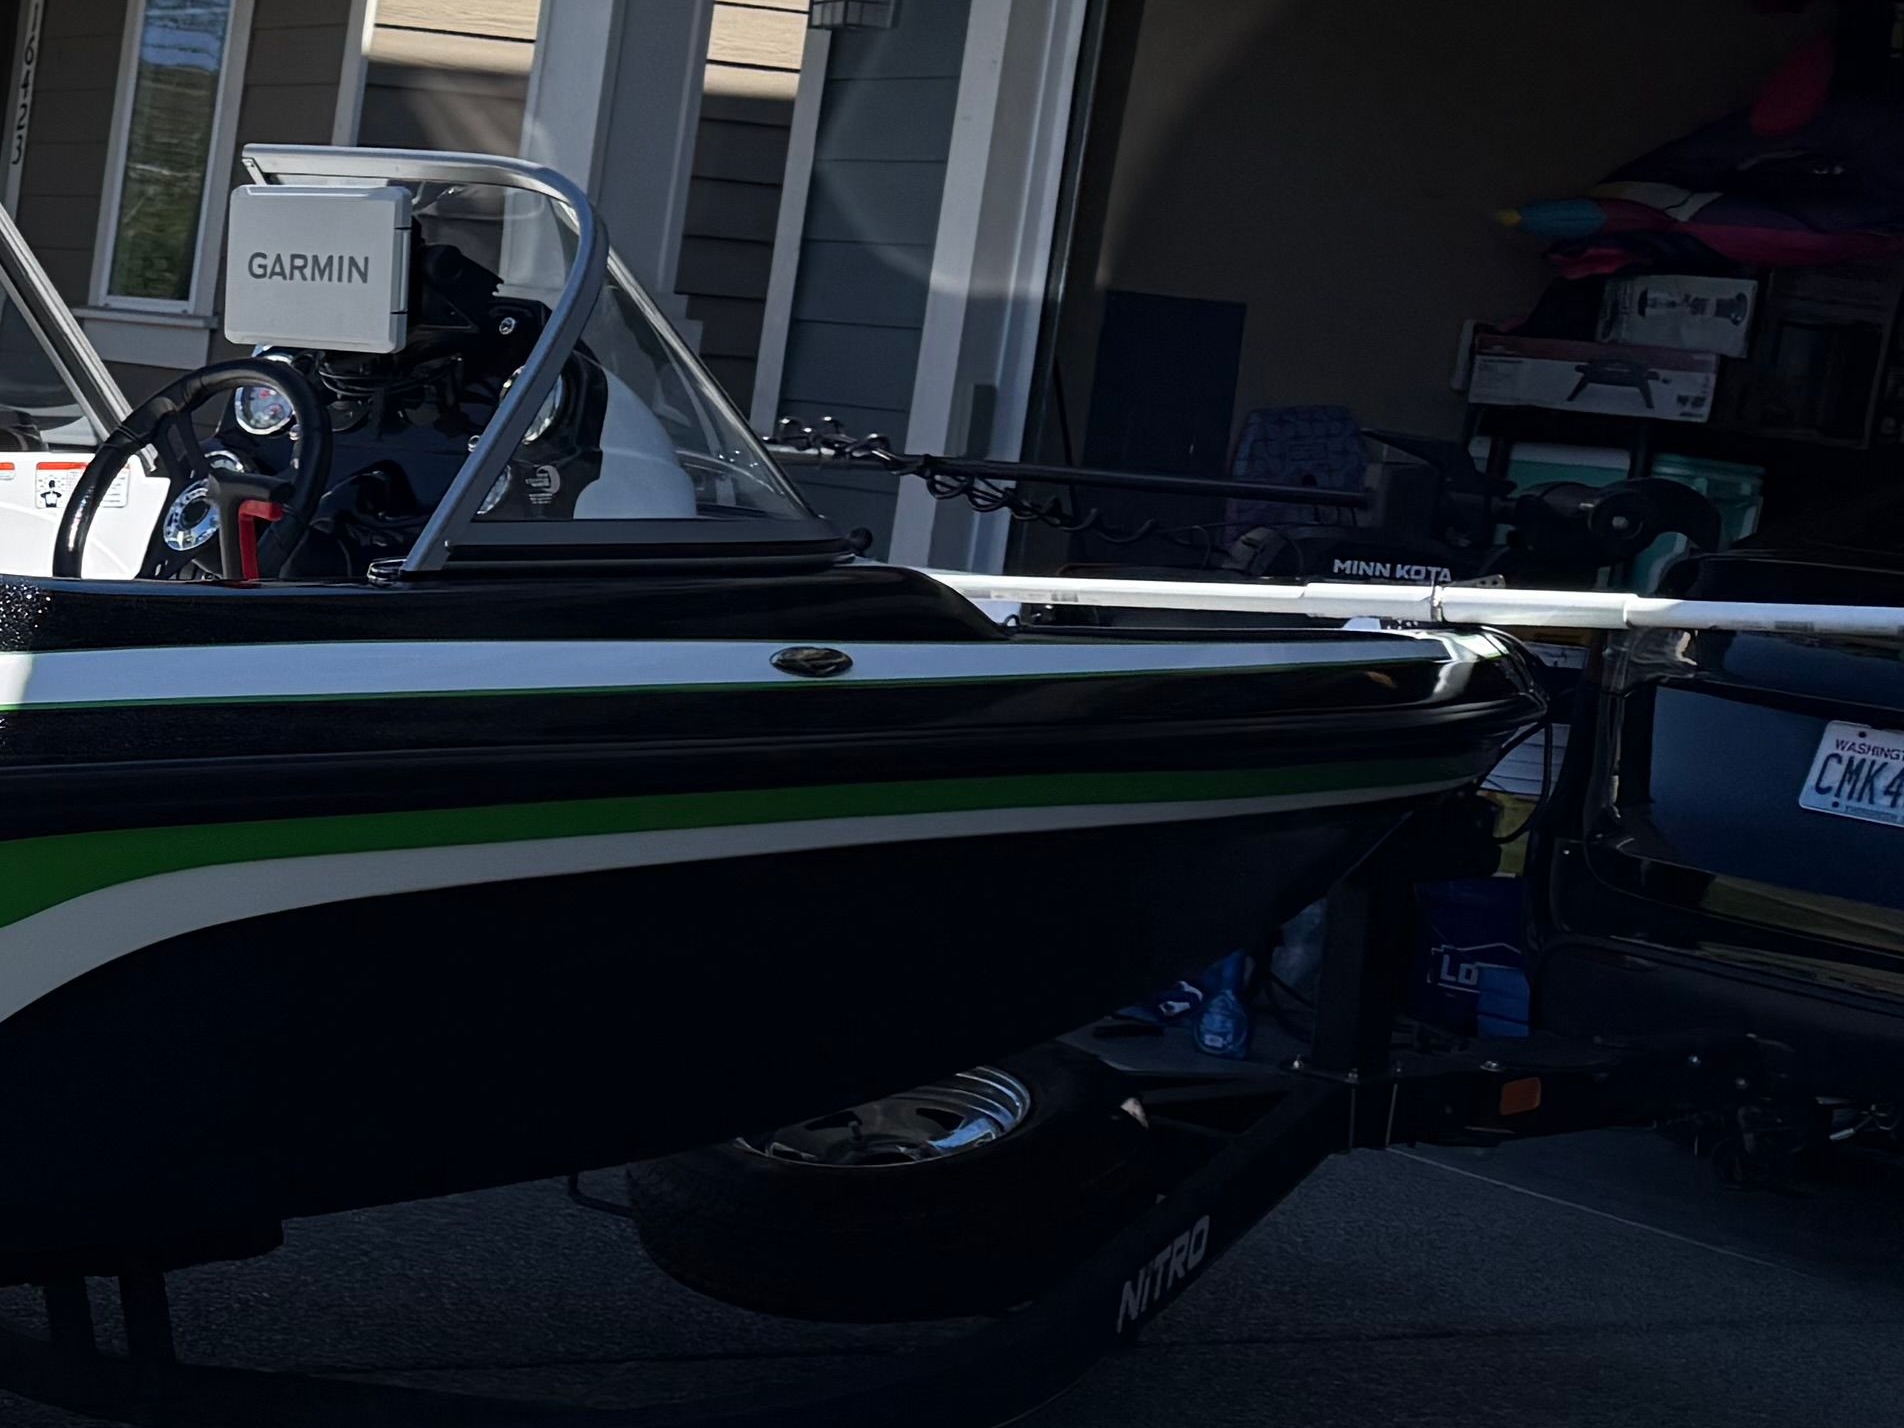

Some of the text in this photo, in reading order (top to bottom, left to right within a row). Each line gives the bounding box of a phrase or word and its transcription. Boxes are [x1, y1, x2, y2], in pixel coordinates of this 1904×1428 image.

[11, 1, 39, 165] 16423
[248, 251, 369, 283] GARMIN
[1333, 559, 1452, 582] MINN KOTA
[1835, 739, 1904, 762] WASHING
[1117, 1214, 1210, 1334] NITRO
